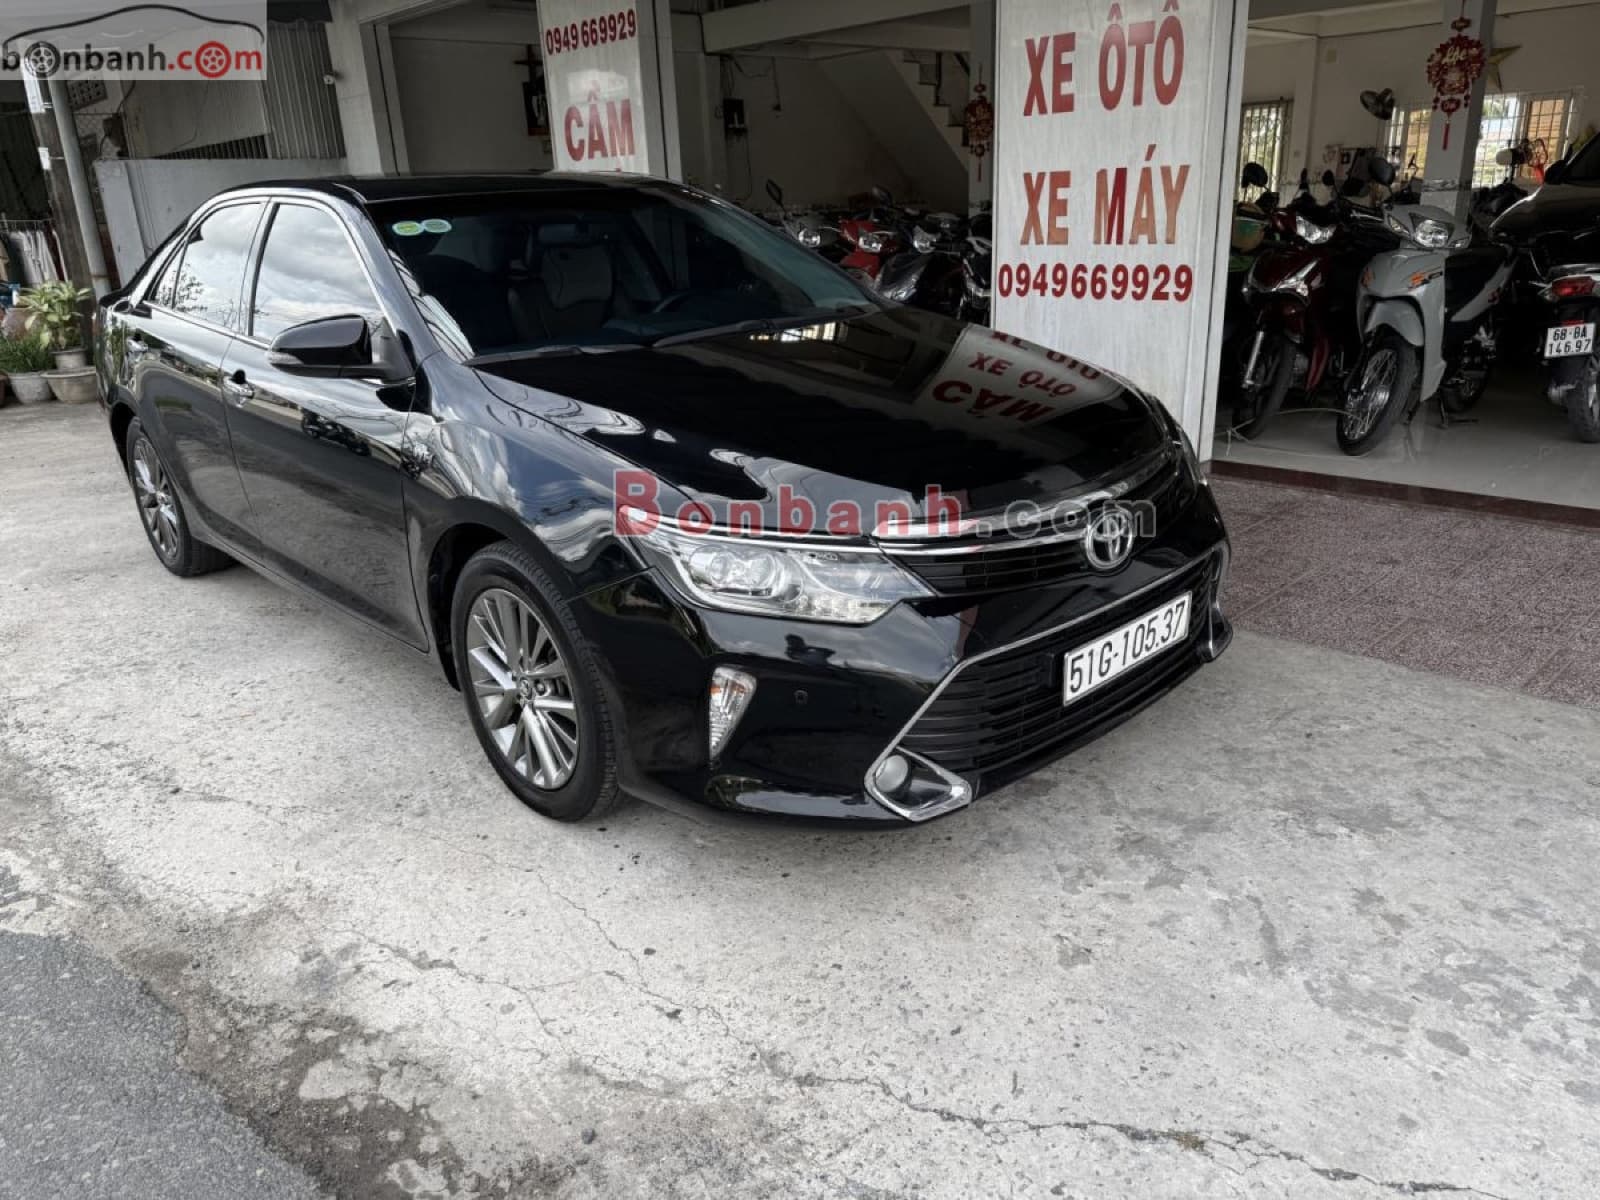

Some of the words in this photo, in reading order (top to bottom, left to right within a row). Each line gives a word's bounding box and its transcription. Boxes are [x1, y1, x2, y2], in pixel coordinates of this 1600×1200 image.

[1023, 32, 1076, 117] XE
[1098, 0, 1185, 111] ÔTÔ
[1020, 171, 1071, 246] XE
[1093, 144, 1191, 246] MÁY
[999, 263, 1193, 302] 0949669929
[1070, 600, 1186, 693] 51G-105.37
